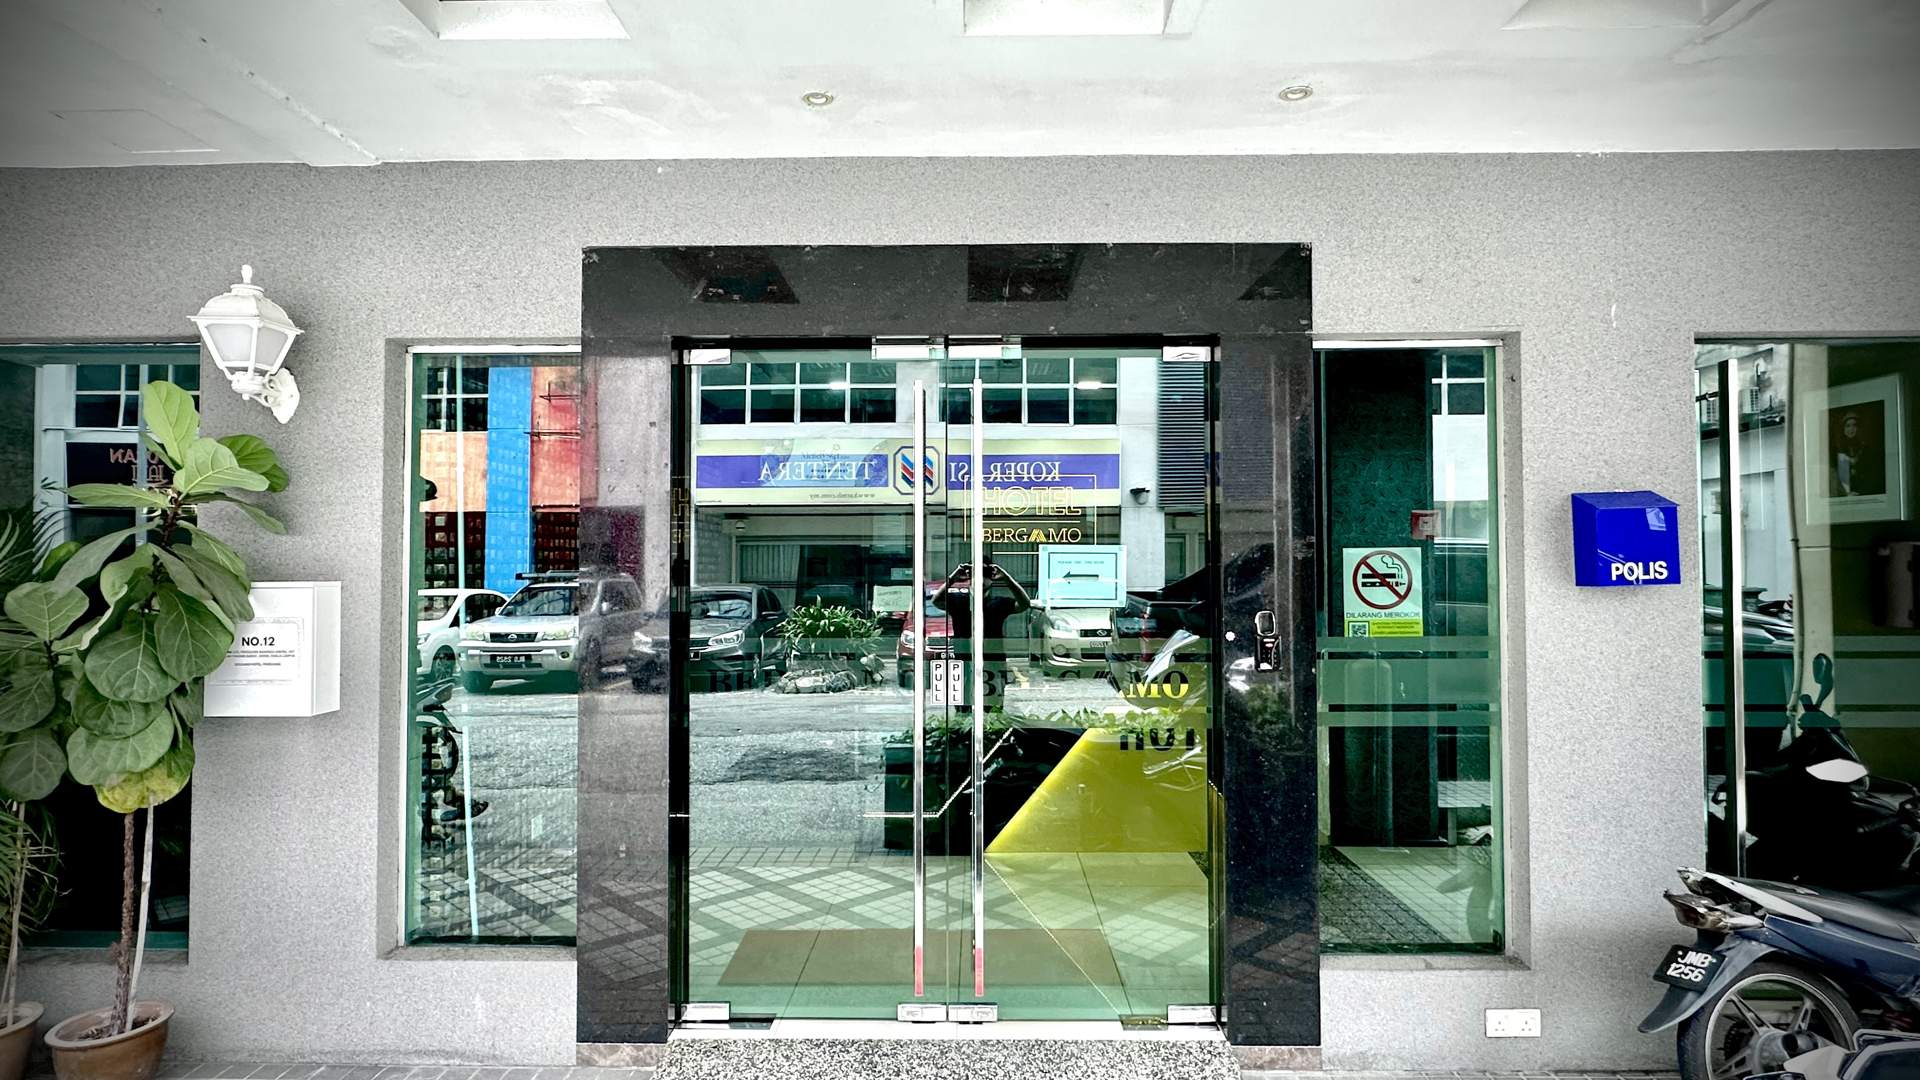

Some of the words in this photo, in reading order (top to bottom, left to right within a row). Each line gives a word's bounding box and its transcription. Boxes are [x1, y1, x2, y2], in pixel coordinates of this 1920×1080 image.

[981, 486, 1082, 516] HOTEL
[982, 528, 1082, 543] BERGAMO
[1611, 560, 1668, 581] POLIS
[241, 636, 275, 647] NO.12
[934, 663, 943, 702] PULL
[952, 663, 961, 702] PULL
[1677, 950, 1713, 968] JMB
[1666, 962, 1706, 982] 1256
